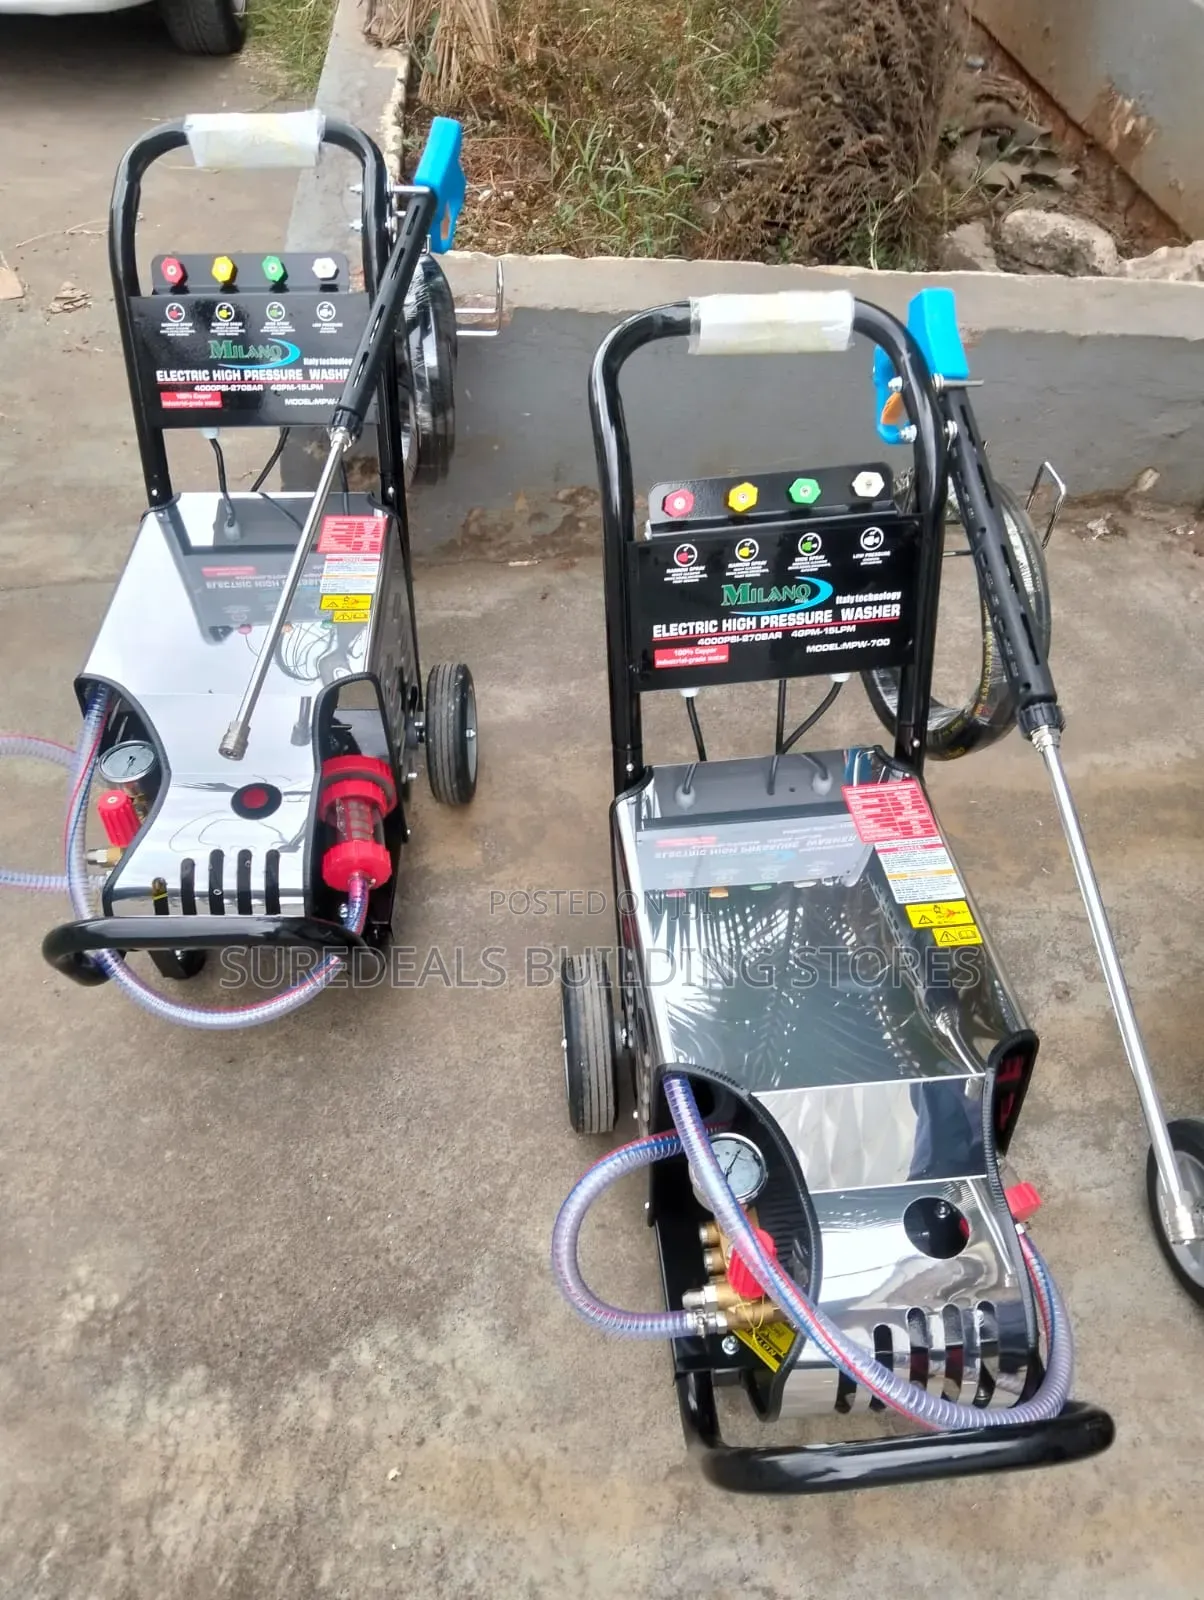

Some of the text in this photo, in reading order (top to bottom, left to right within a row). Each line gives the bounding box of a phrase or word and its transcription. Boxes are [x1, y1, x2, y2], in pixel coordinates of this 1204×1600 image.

[207, 339, 283, 360] MILANO
[156, 368, 350, 382] ELECTRIC HIGH PRESSURE WASHE
[720, 582, 811, 606] MILANO
[653, 603, 901, 638] ELECTRIC HIGH PRESSURE WASHER
[697, 631, 783, 646] 4000PSI-270BAR
[806, 638, 891, 654] MODEL:MPW-700
